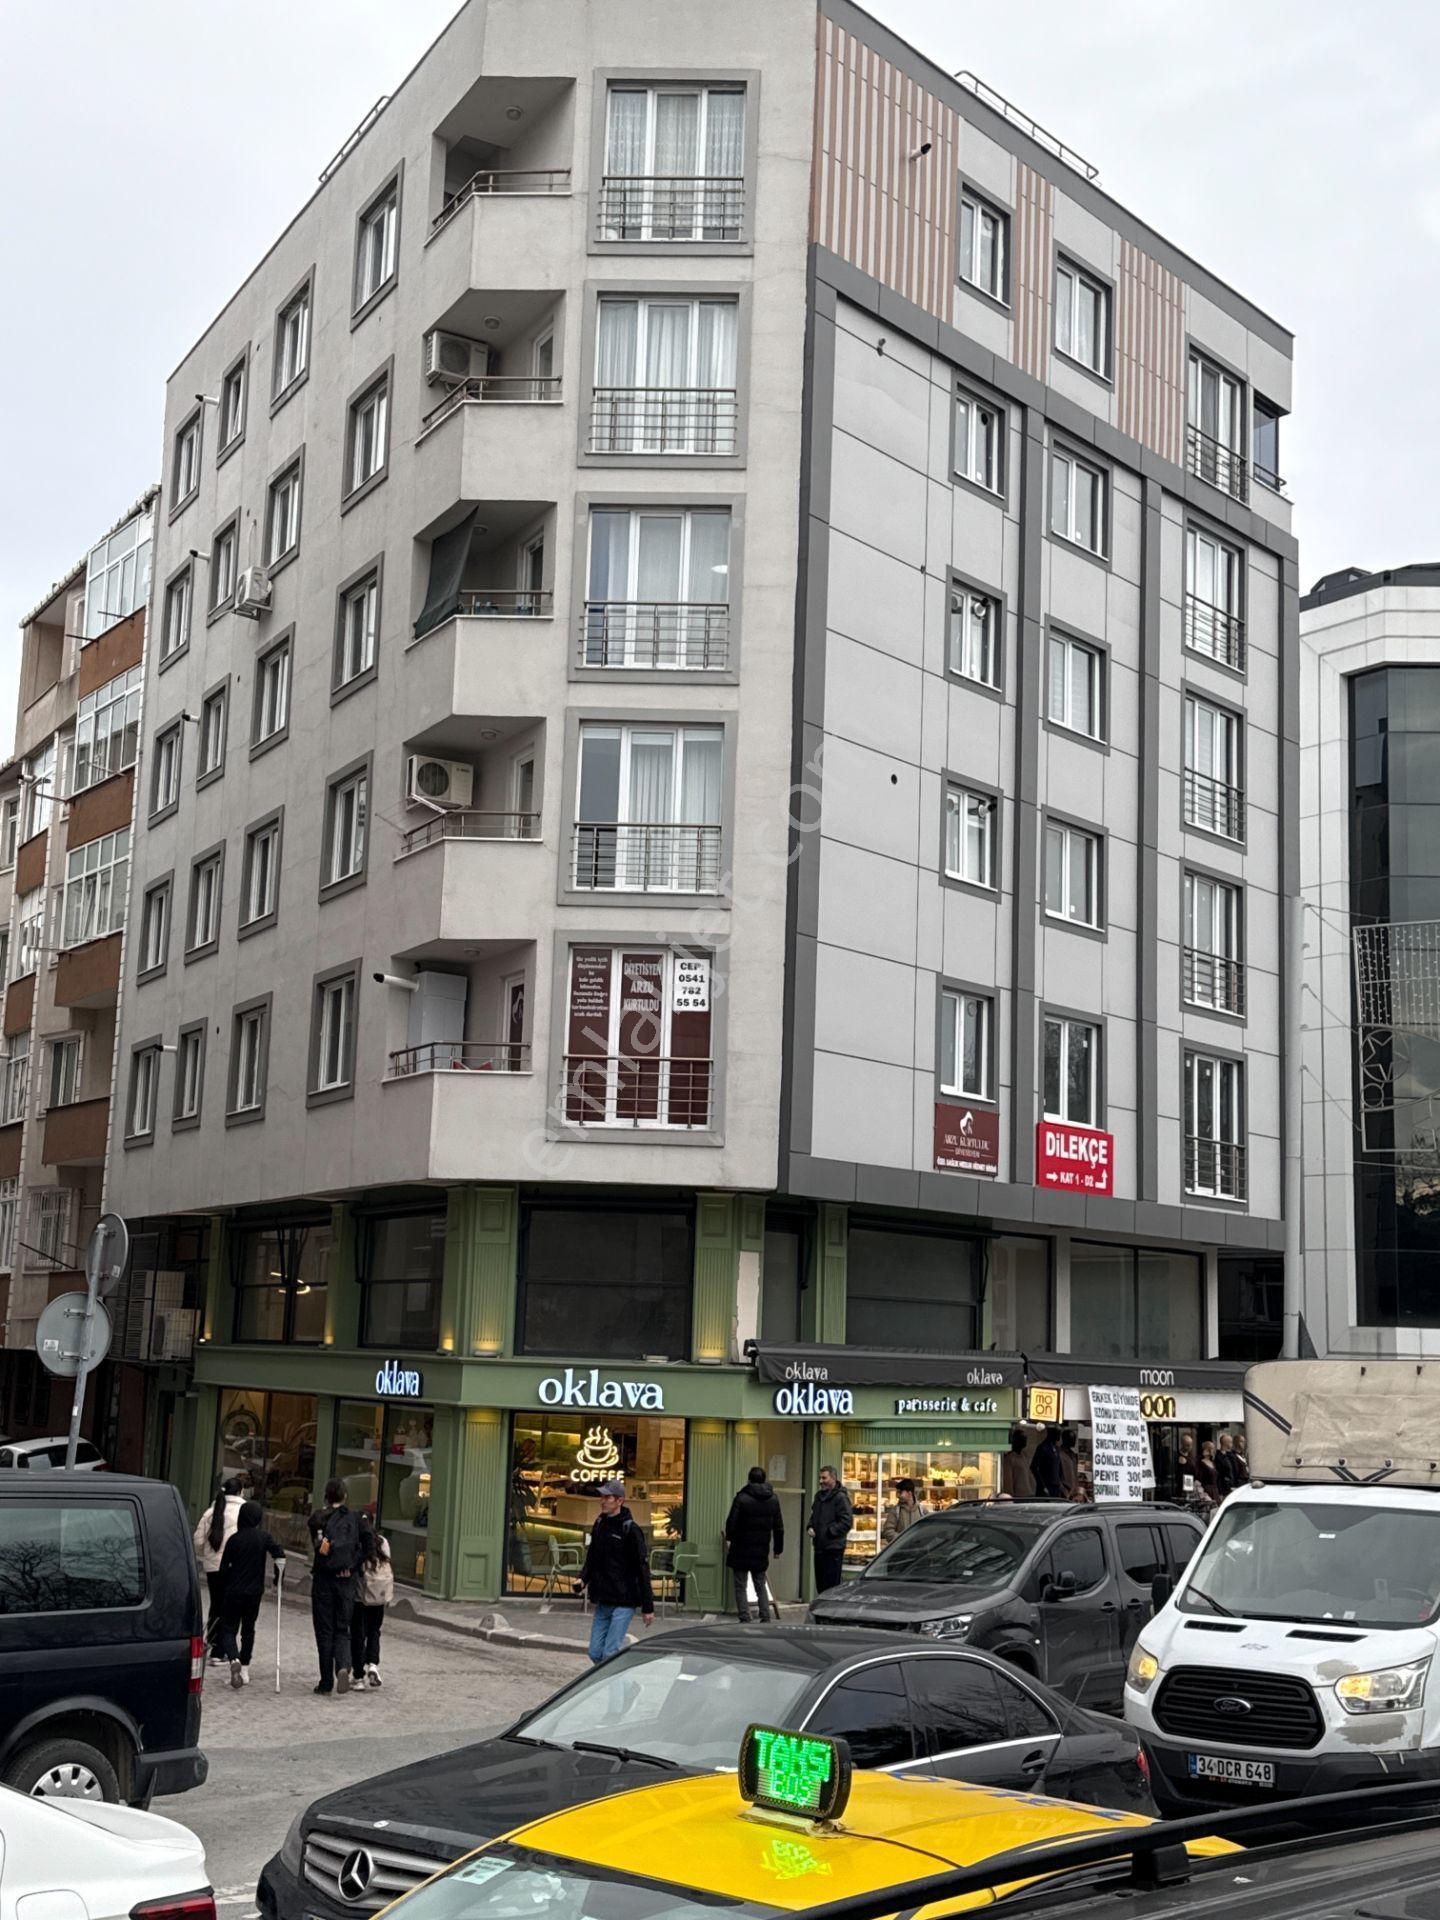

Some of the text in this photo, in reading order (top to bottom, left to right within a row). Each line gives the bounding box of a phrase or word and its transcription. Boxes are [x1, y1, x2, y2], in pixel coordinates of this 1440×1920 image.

[678, 974, 705, 982] 0541
[682, 986, 702, 995] 782
[676, 998, 706, 1007] 55 54
[1060, 1172, 1073, 1184] KAT
[1075, 1173, 1079, 1185] 1
[375, 1360, 420, 1396] oklava
[785, 1362, 828, 1380] oklava
[967, 1368, 1003, 1385] oklava
[1140, 1369, 1175, 1386] moon
[538, 1368, 664, 1410] oklava
[776, 1382, 854, 1414] oklava
[898, 1398, 998, 1414] patisserie & cafe
[1096, 1423, 1116, 1434] KAZAK
[570, 1469, 625, 1483] COFFEE
[1094, 1470, 1119, 1482] PENYE
[1198, 1758, 1214, 1773] 34
[1217, 1761, 1241, 1778] DCR
[1246, 1764, 1272, 1781] 648
